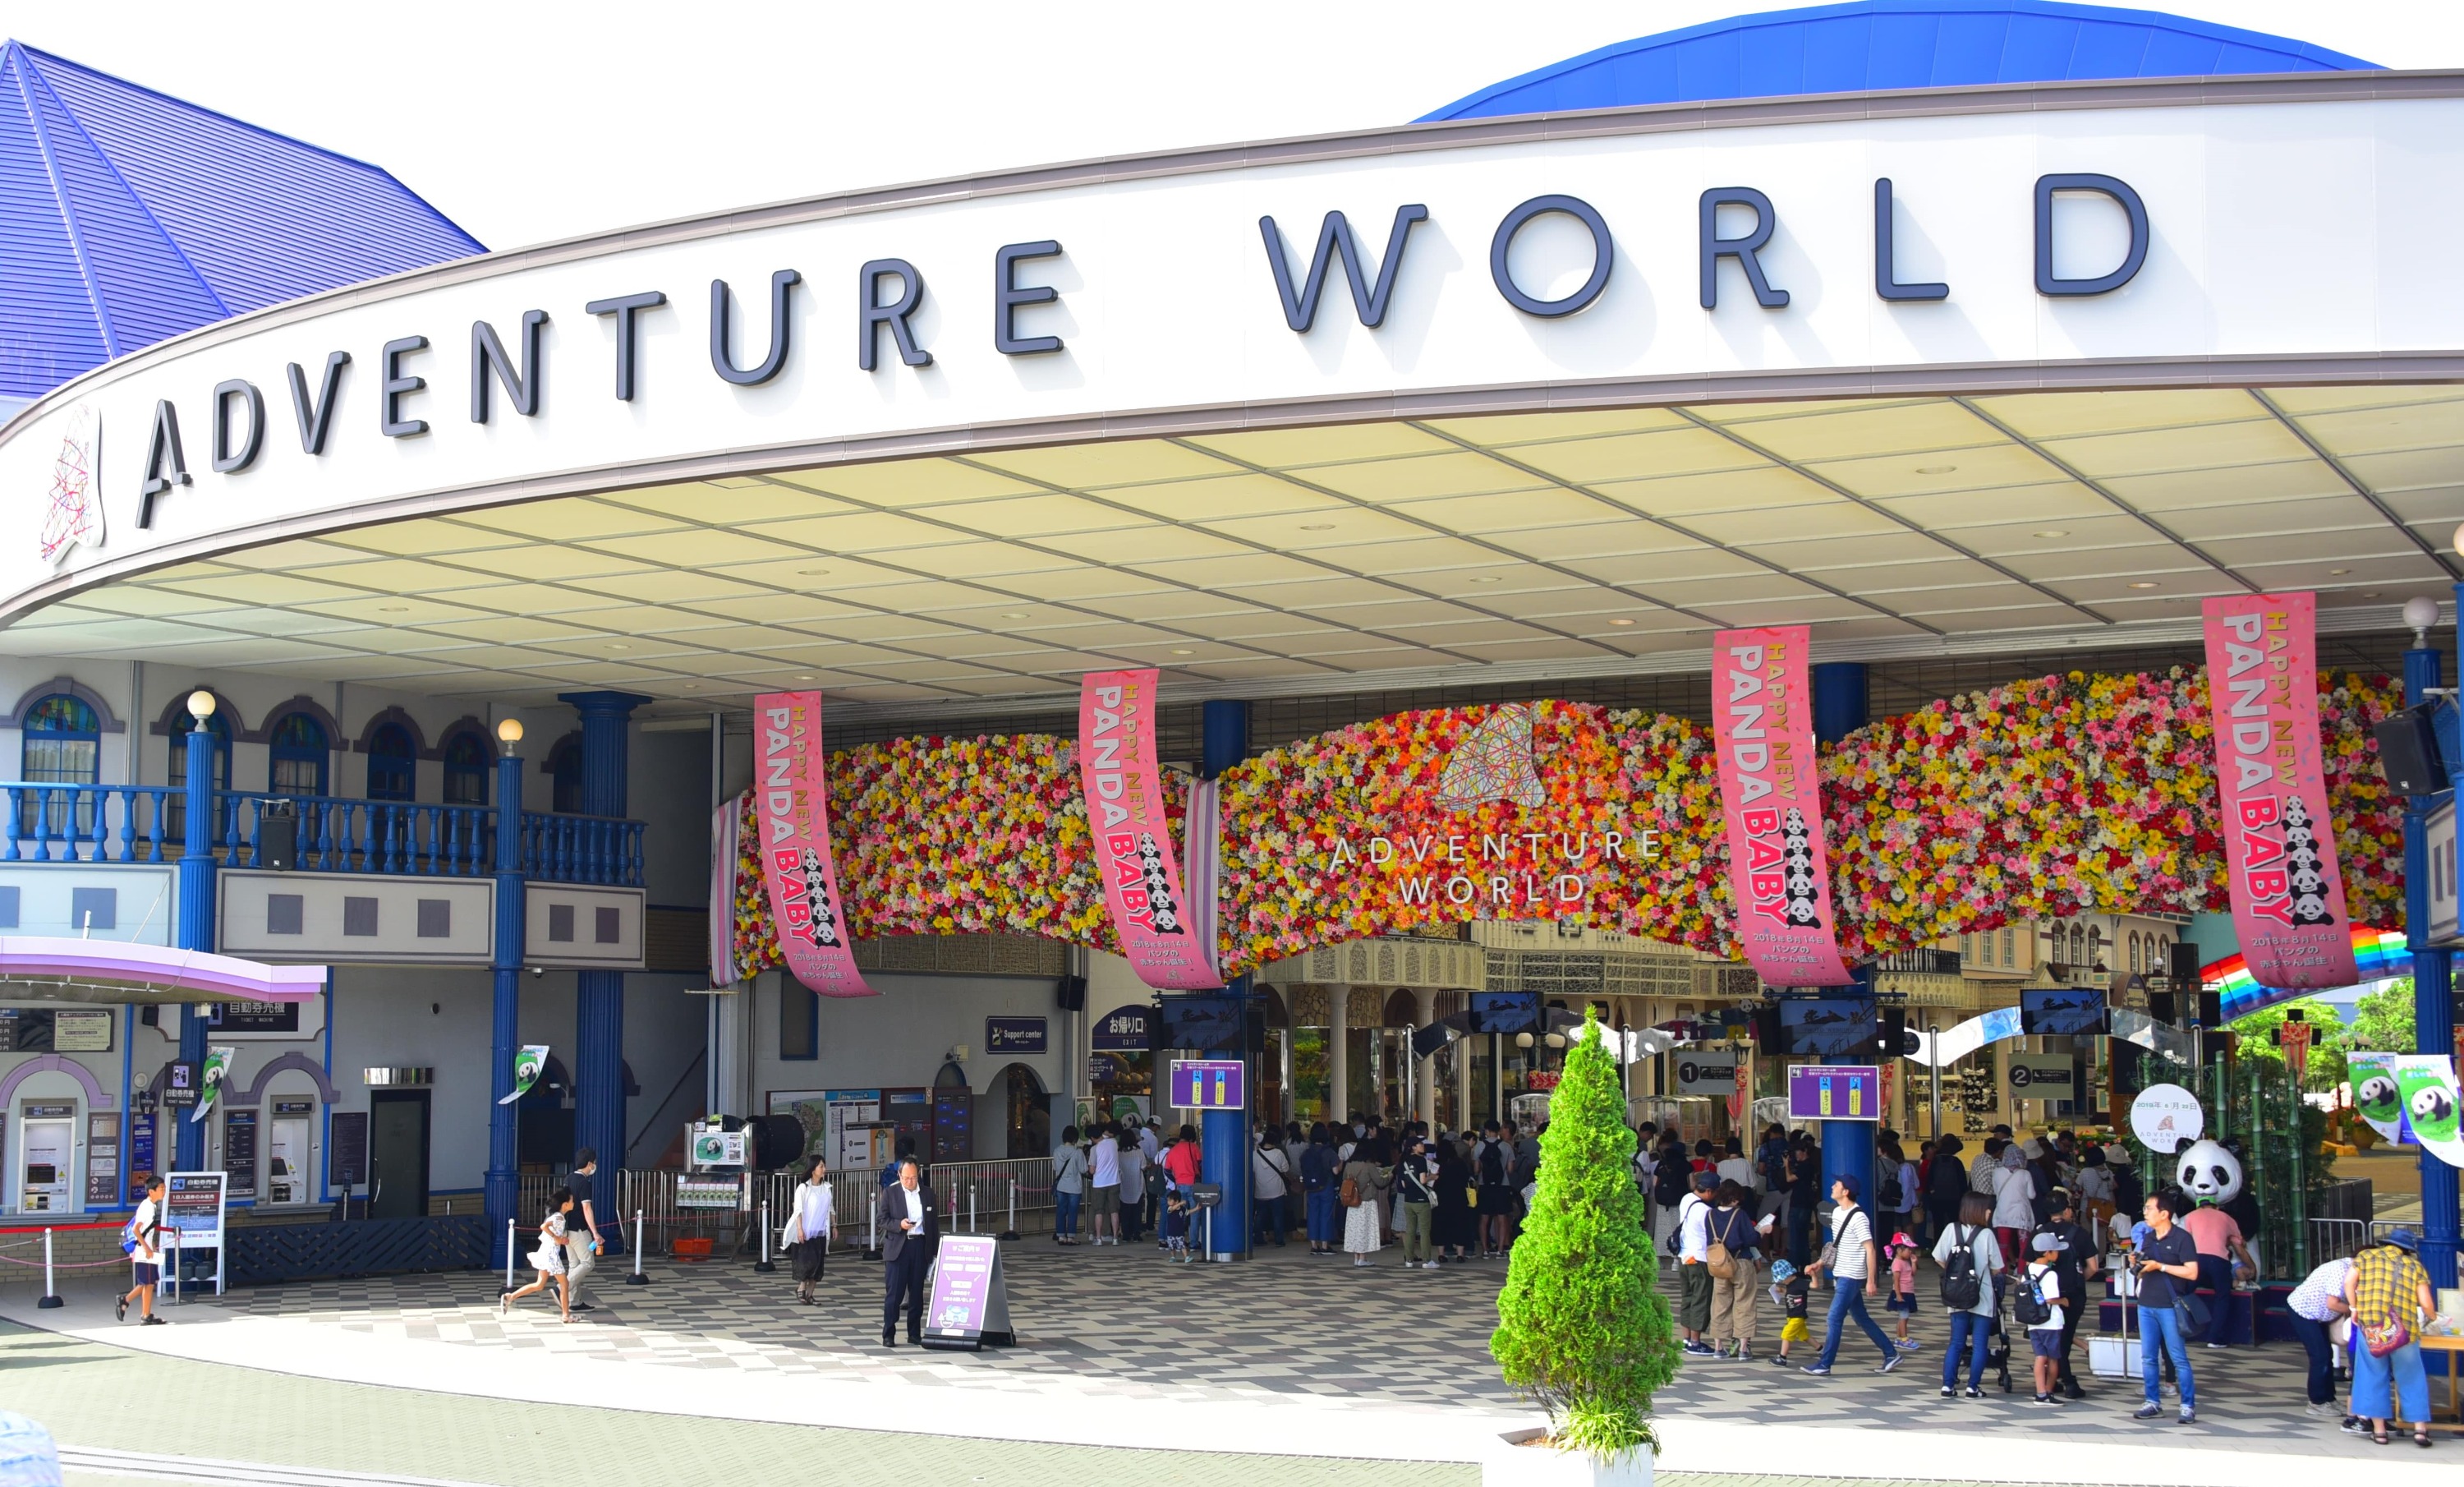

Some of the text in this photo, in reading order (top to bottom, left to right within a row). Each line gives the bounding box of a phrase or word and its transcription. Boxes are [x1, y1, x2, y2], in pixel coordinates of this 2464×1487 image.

[135, 173, 2150, 529] ADVENTURE WORLD
[2223, 612, 2274, 792] PANDA
[2264, 611, 2299, 788] HAPPY NEW
[1729, 646, 1774, 804] PANDA
[1766, 643, 1798, 800] HAPPY NEW
[765, 707, 796, 844] PANDA
[793, 706, 813, 842] HAPPY NEW
[1092, 685, 1129, 829] PANDA
[1122, 684, 1149, 826] HAPPY NEW
[1330, 830, 1661, 872] ADVENTURE
[1741, 807, 1791, 930] BABY
[2236, 794, 2296, 931] BABY
[772, 847, 818, 949] BABY
[1106, 831, 1160, 936] BABY
[1400, 873, 1585, 905] WORLD
[793, 953, 846, 961] 2018年8月14日
[1132, 940, 1190, 949] 2018年8月14日
[1147, 950, 1179, 958] パンダの
[1754, 932, 1825, 944] 2018年8月14日
[1772, 945, 1810, 955] パンダの
[2251, 932, 2339, 946] 2018年8月14日
[2273, 946, 2319, 956] パンダの
[229, 1002, 286, 1014] 自動券売機
[1004, 1029, 1042, 1040] Support center
[166, 1089, 195, 1098] 自動券売機
[1685, 1066, 1692, 1080] 1
[2014, 1069, 2028, 1084] 2
